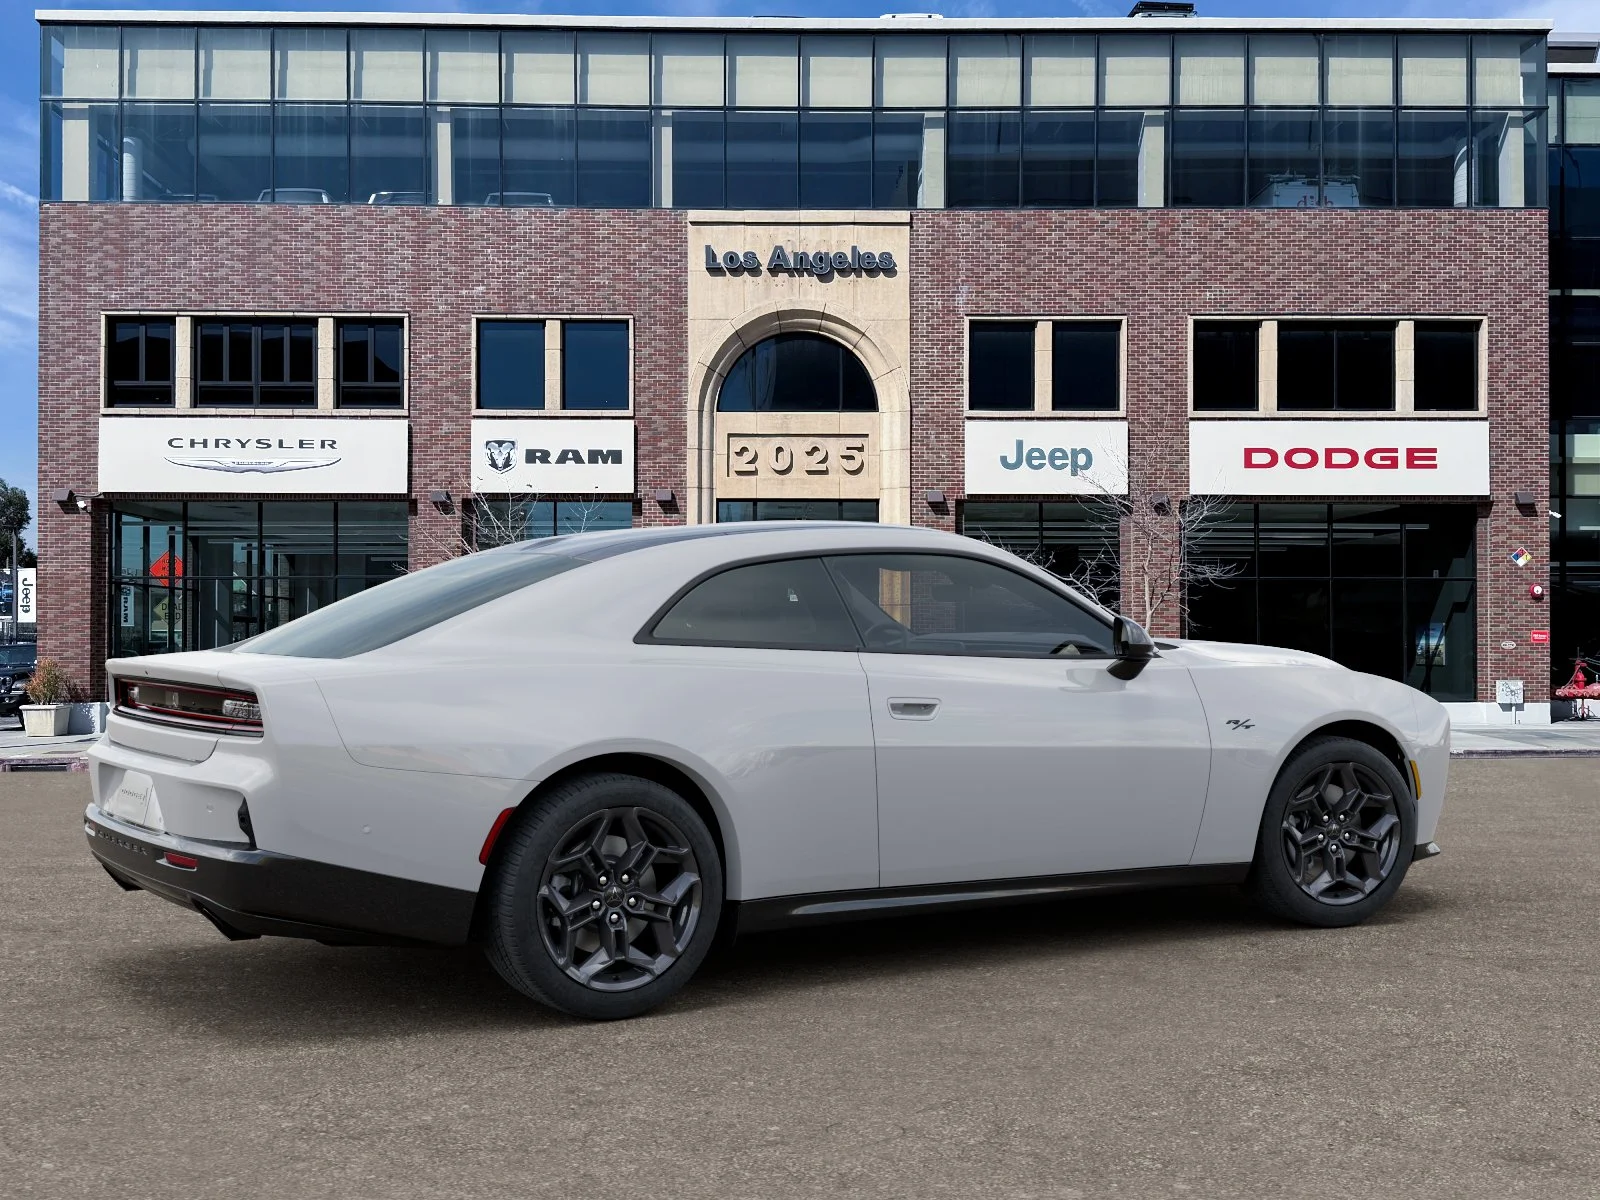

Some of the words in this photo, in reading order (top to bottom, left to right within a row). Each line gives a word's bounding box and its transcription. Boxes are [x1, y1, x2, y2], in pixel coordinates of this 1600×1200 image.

[704, 244, 760, 271] Los
[766, 244, 896, 276] Angeles
[167, 437, 338, 450] CHRYSLER
[524, 448, 623, 465] RAM
[733, 440, 865, 476] 2025
[999, 438, 1093, 477] Jeep
[1243, 447, 1438, 469] DODGE
[20, 577, 34, 614] Jeep
[164, 612, 181, 620] ED
[1225, 718, 1256, 731] R/T
